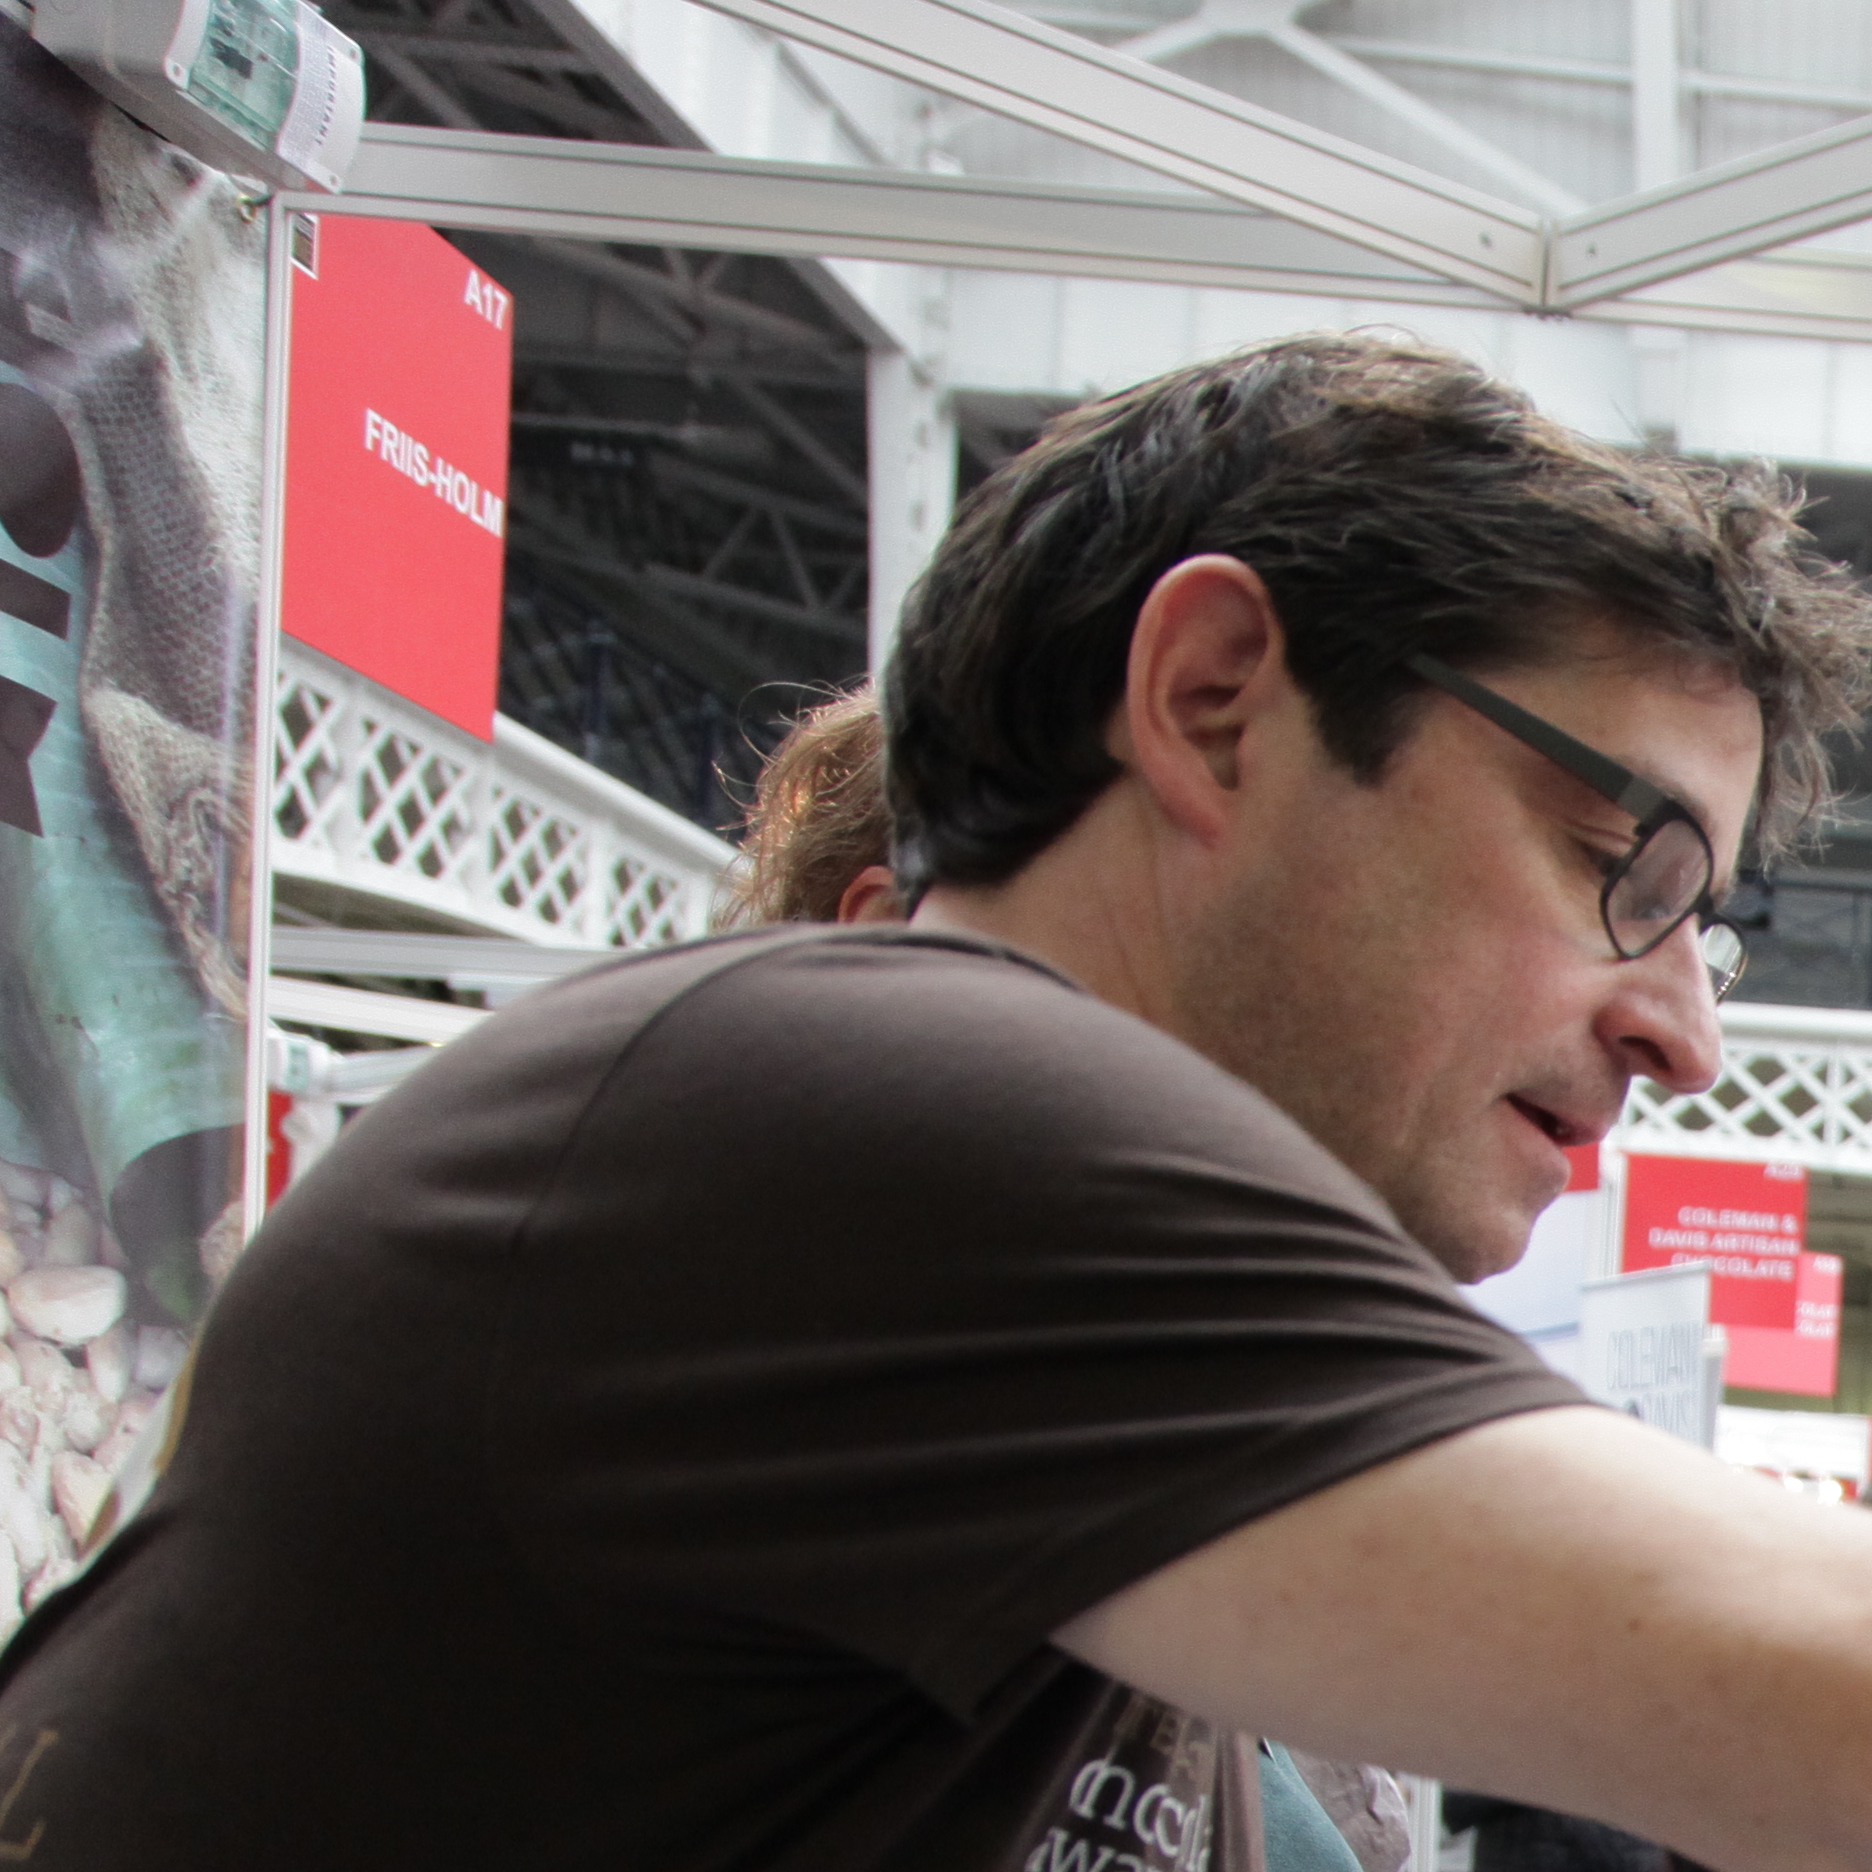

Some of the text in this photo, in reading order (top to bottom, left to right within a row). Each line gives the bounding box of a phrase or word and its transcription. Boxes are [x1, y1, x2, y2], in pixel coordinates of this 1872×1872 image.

[463, 270, 509, 330] A17
[363, 408, 505, 540] FRIIS-HOLM
[1677, 1205, 1779, 1232] COLEMAN
[1648, 1227, 1801, 1257] DAVIS ARTISAN
